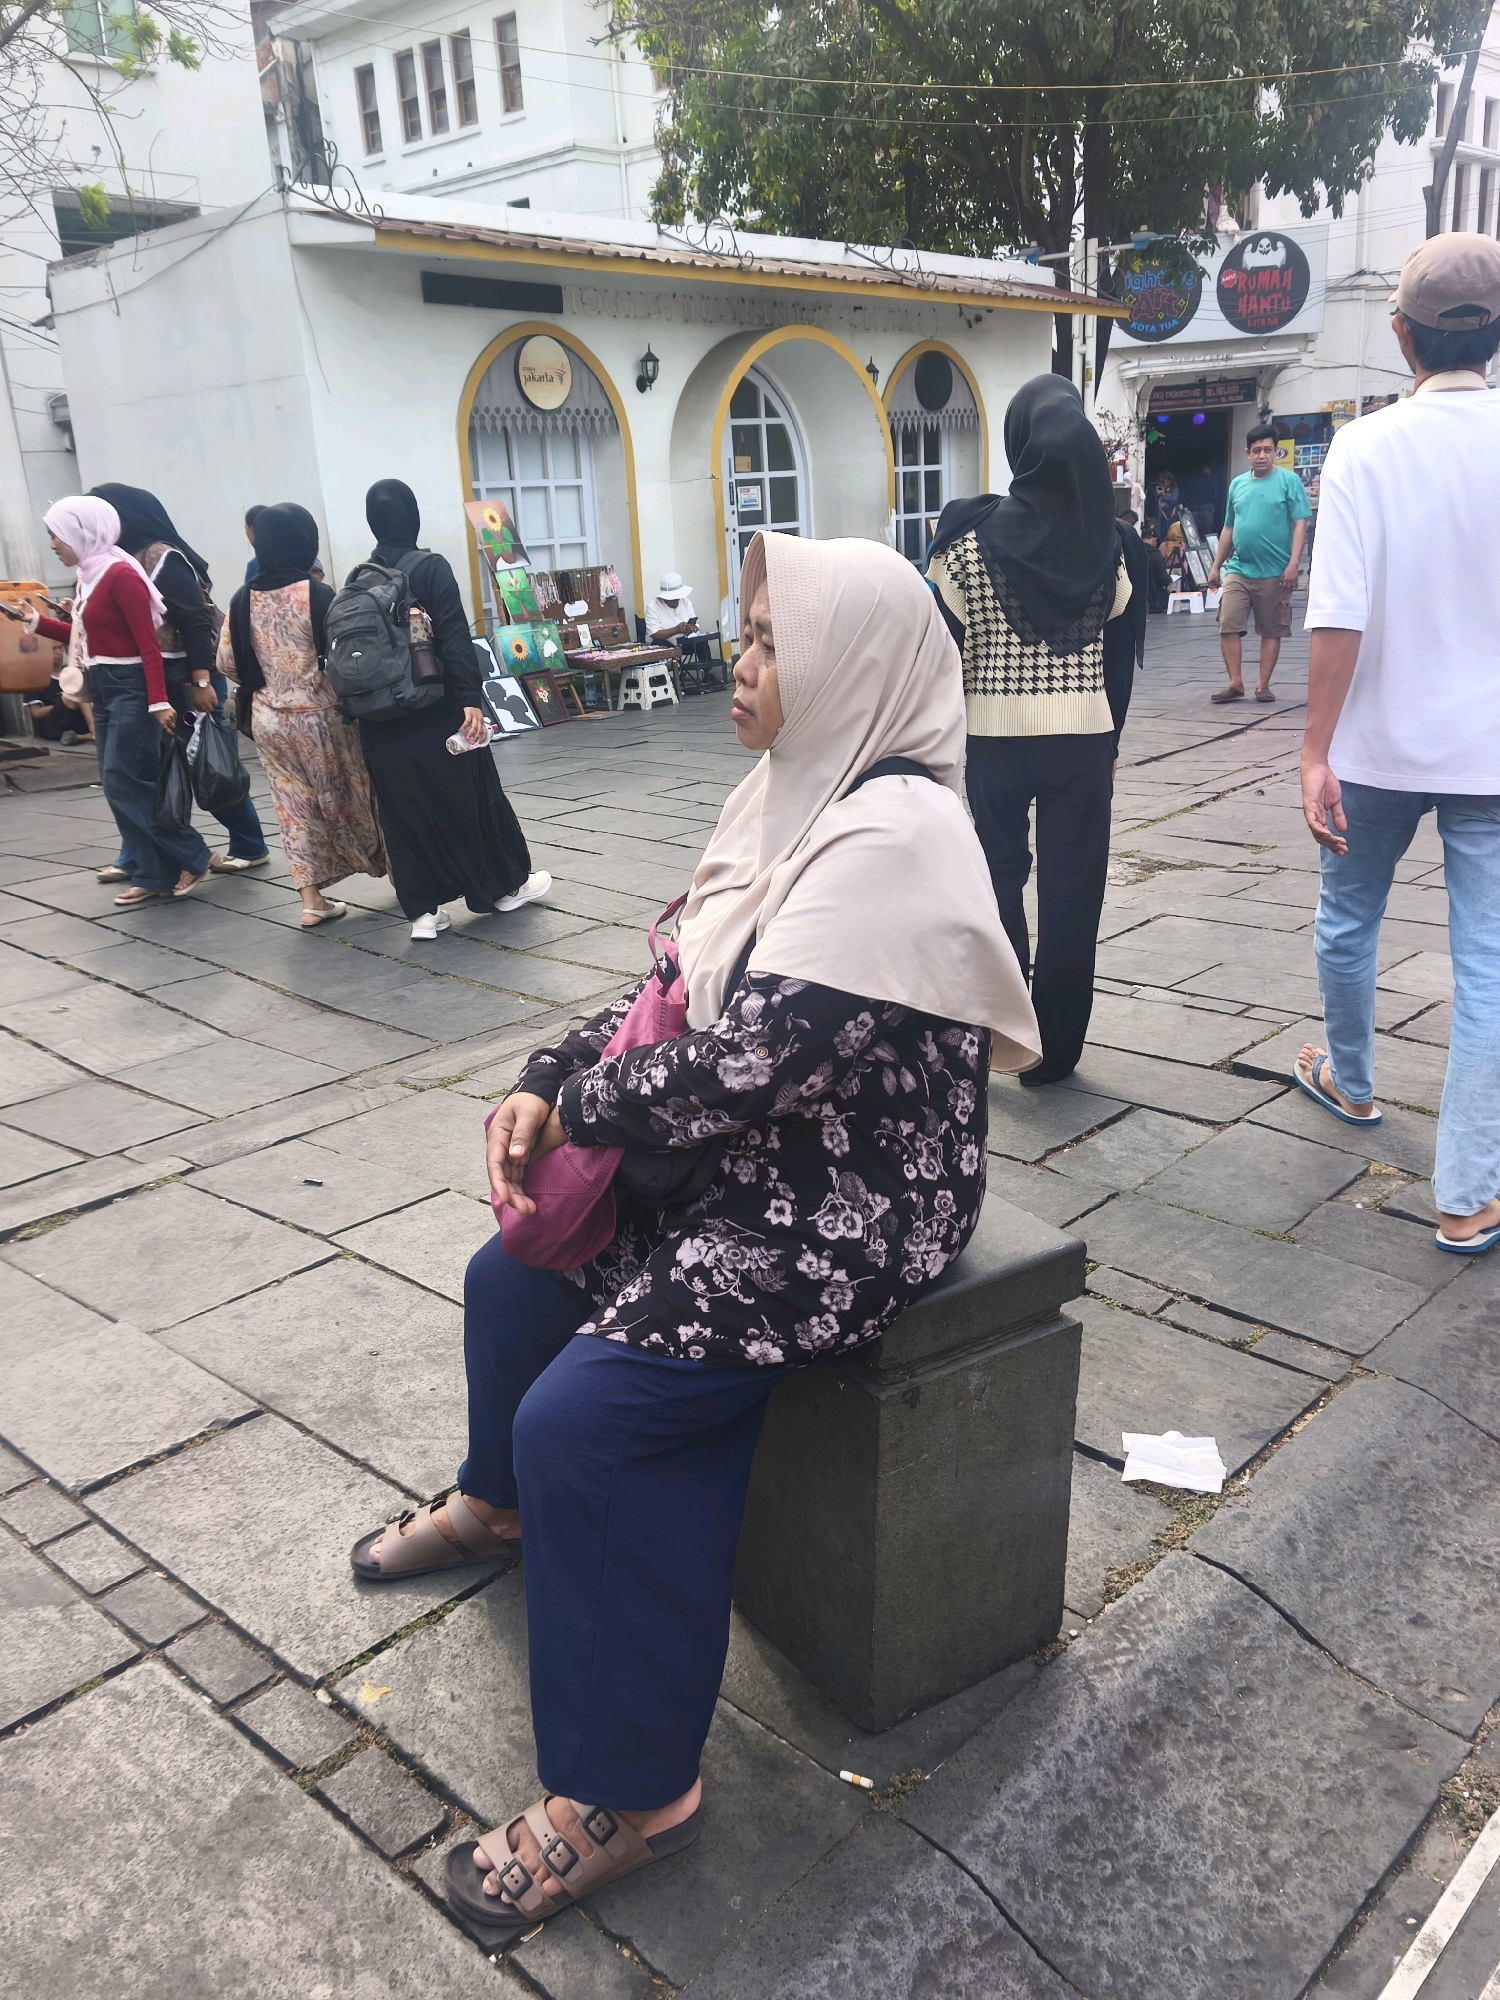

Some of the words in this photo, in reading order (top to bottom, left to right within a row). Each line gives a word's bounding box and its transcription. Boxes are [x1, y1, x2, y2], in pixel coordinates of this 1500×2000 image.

[1236, 267, 1293, 293] RUMAH
[564, 286, 673, 322] TOURIST
[683, 294, 834, 327] INFORMATION
[1131, 288, 1180, 320] Art
[1237, 292, 1291, 317] HANTU
[1130, 320, 1156, 333] KOTA
[1158, 318, 1179, 332] TUA
[523, 371, 554, 386] jakarta
